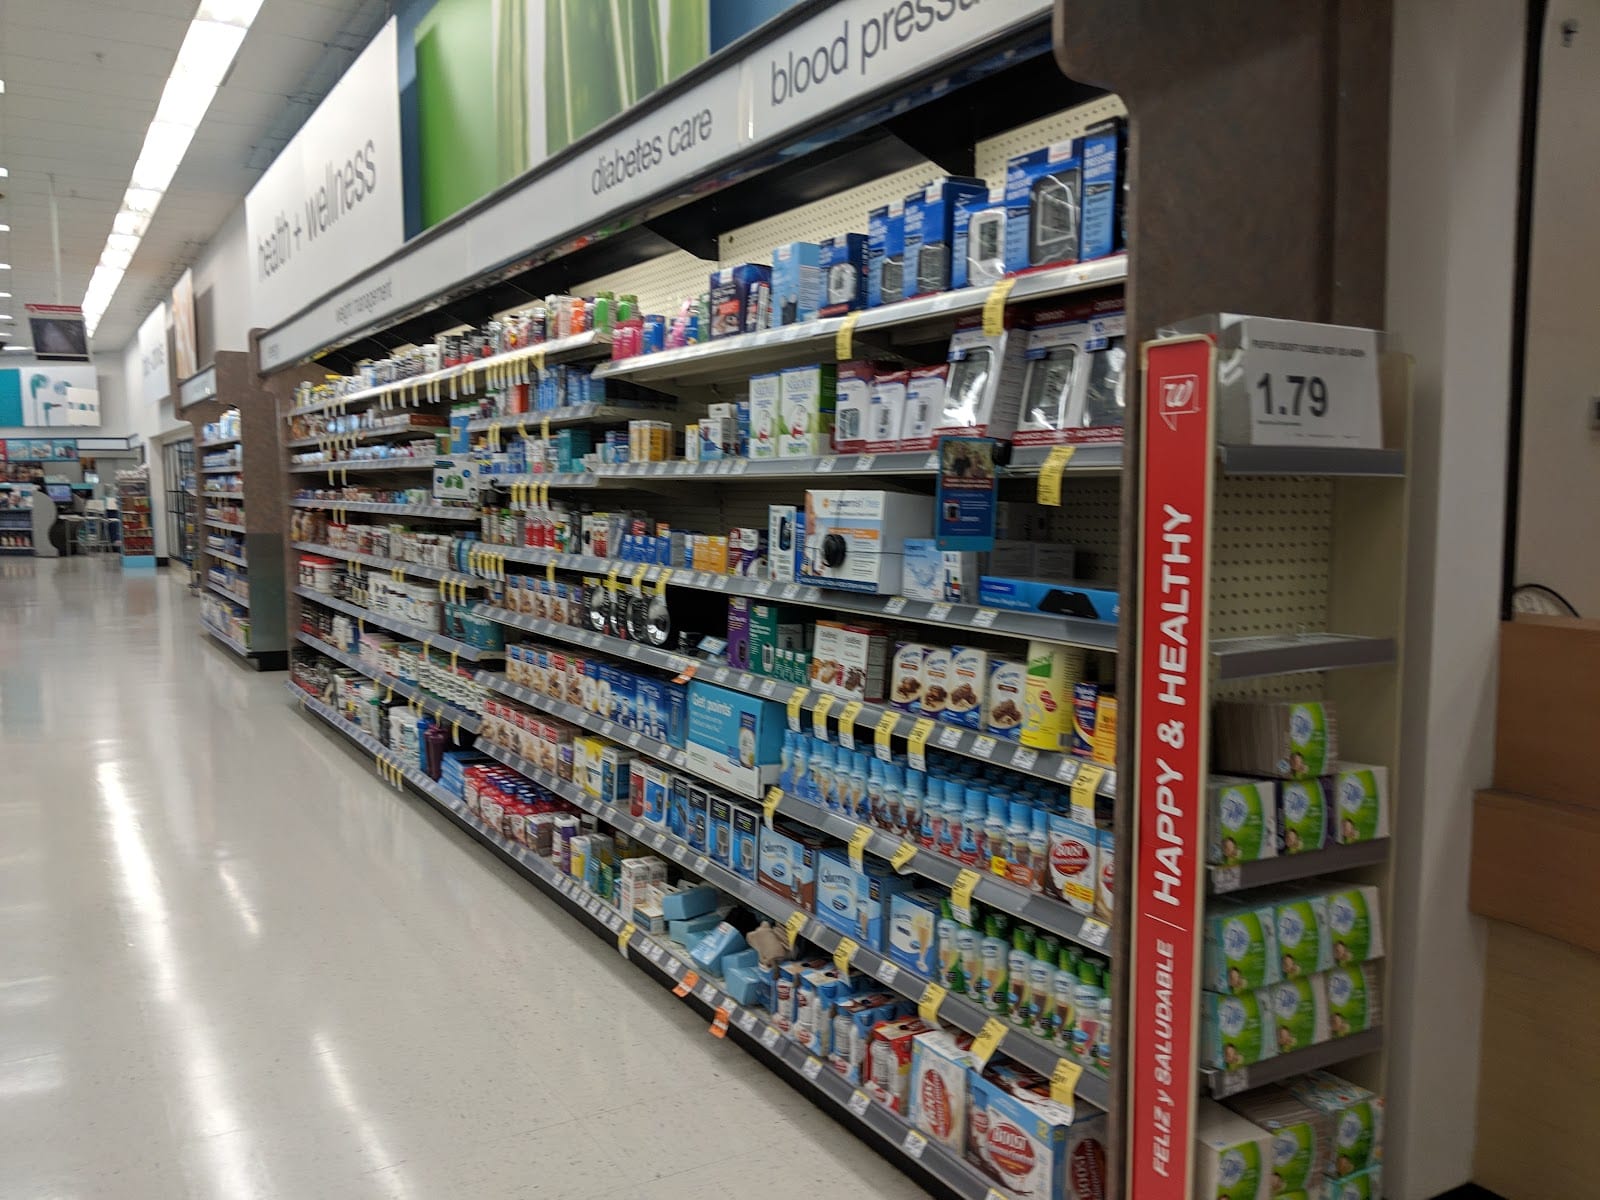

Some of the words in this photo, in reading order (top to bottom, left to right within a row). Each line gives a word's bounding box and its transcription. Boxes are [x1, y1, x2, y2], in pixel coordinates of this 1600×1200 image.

[770, 20, 849, 106] blood
[305, 138, 377, 241] wellness
[590, 133, 663, 196] diabetes
[667, 107, 713, 154] care
[1256, 372, 1329, 418] 1.79
[1157, 503, 1193, 706] HEALTHY
[1156, 720, 1186, 750] &
[1152, 757, 1185, 907] HAPPY
[1154, 938, 1175, 1087] SALUDABLE
[1158, 1089, 1175, 1107] y
[1152, 1109, 1175, 1178] FELIZ
